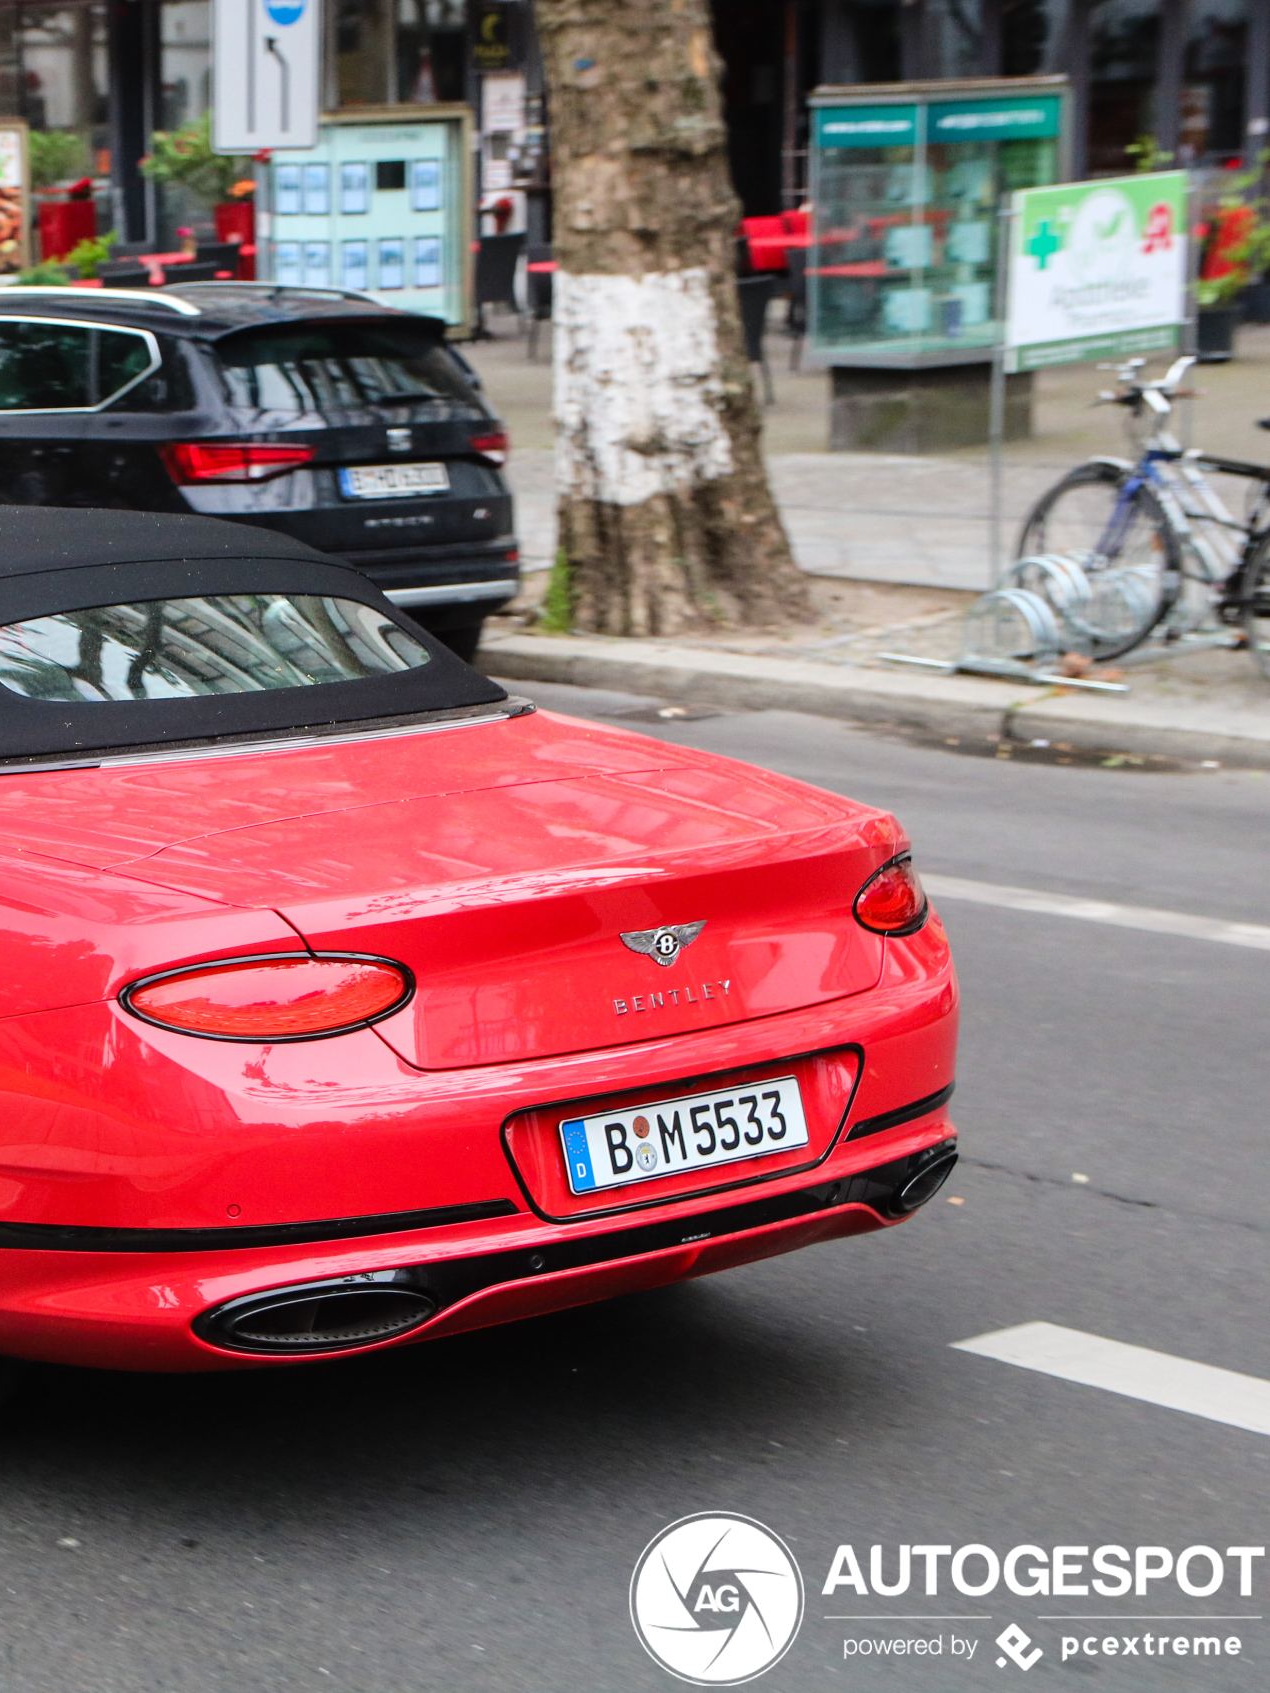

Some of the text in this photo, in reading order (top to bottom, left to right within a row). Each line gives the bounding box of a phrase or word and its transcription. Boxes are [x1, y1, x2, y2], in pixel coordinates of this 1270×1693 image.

[614, 979, 731, 1016] BENTLEY
[604, 1123, 634, 1175] B
[576, 1161, 587, 1179] D
